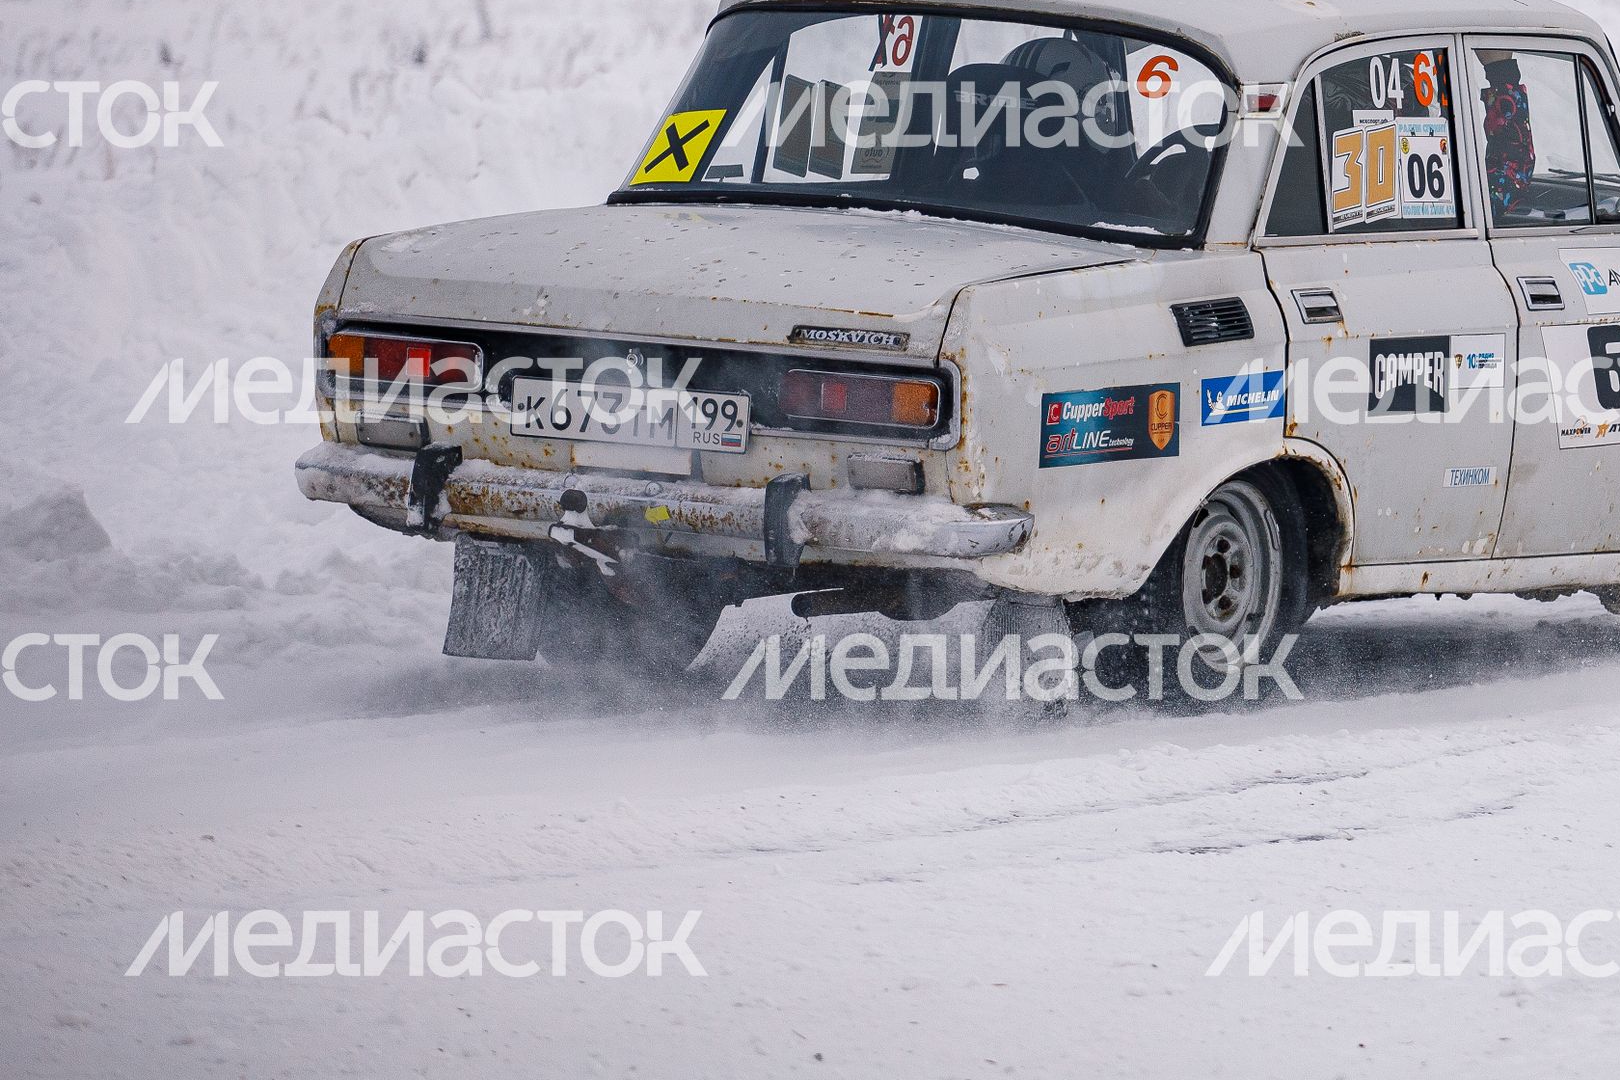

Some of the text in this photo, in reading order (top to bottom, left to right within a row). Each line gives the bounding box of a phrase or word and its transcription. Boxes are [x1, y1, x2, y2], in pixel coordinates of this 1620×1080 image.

[1136, 55, 1179, 99] 6
[1369, 56, 1404, 109] 04
[1333, 126, 1396, 213] 30
[1407, 153, 1446, 199] 06
[799, 328, 899, 346] MOSKVICH
[1374, 351, 1445, 400] CAMPER
[683, 396, 739, 432] 199
[1062, 396, 1136, 423] CupperSport
[1226, 389, 1280, 407] MICHELIN
[692, 431, 720, 445] RUS
[1449, 468, 1490, 486] ТЕХИНКОМ
